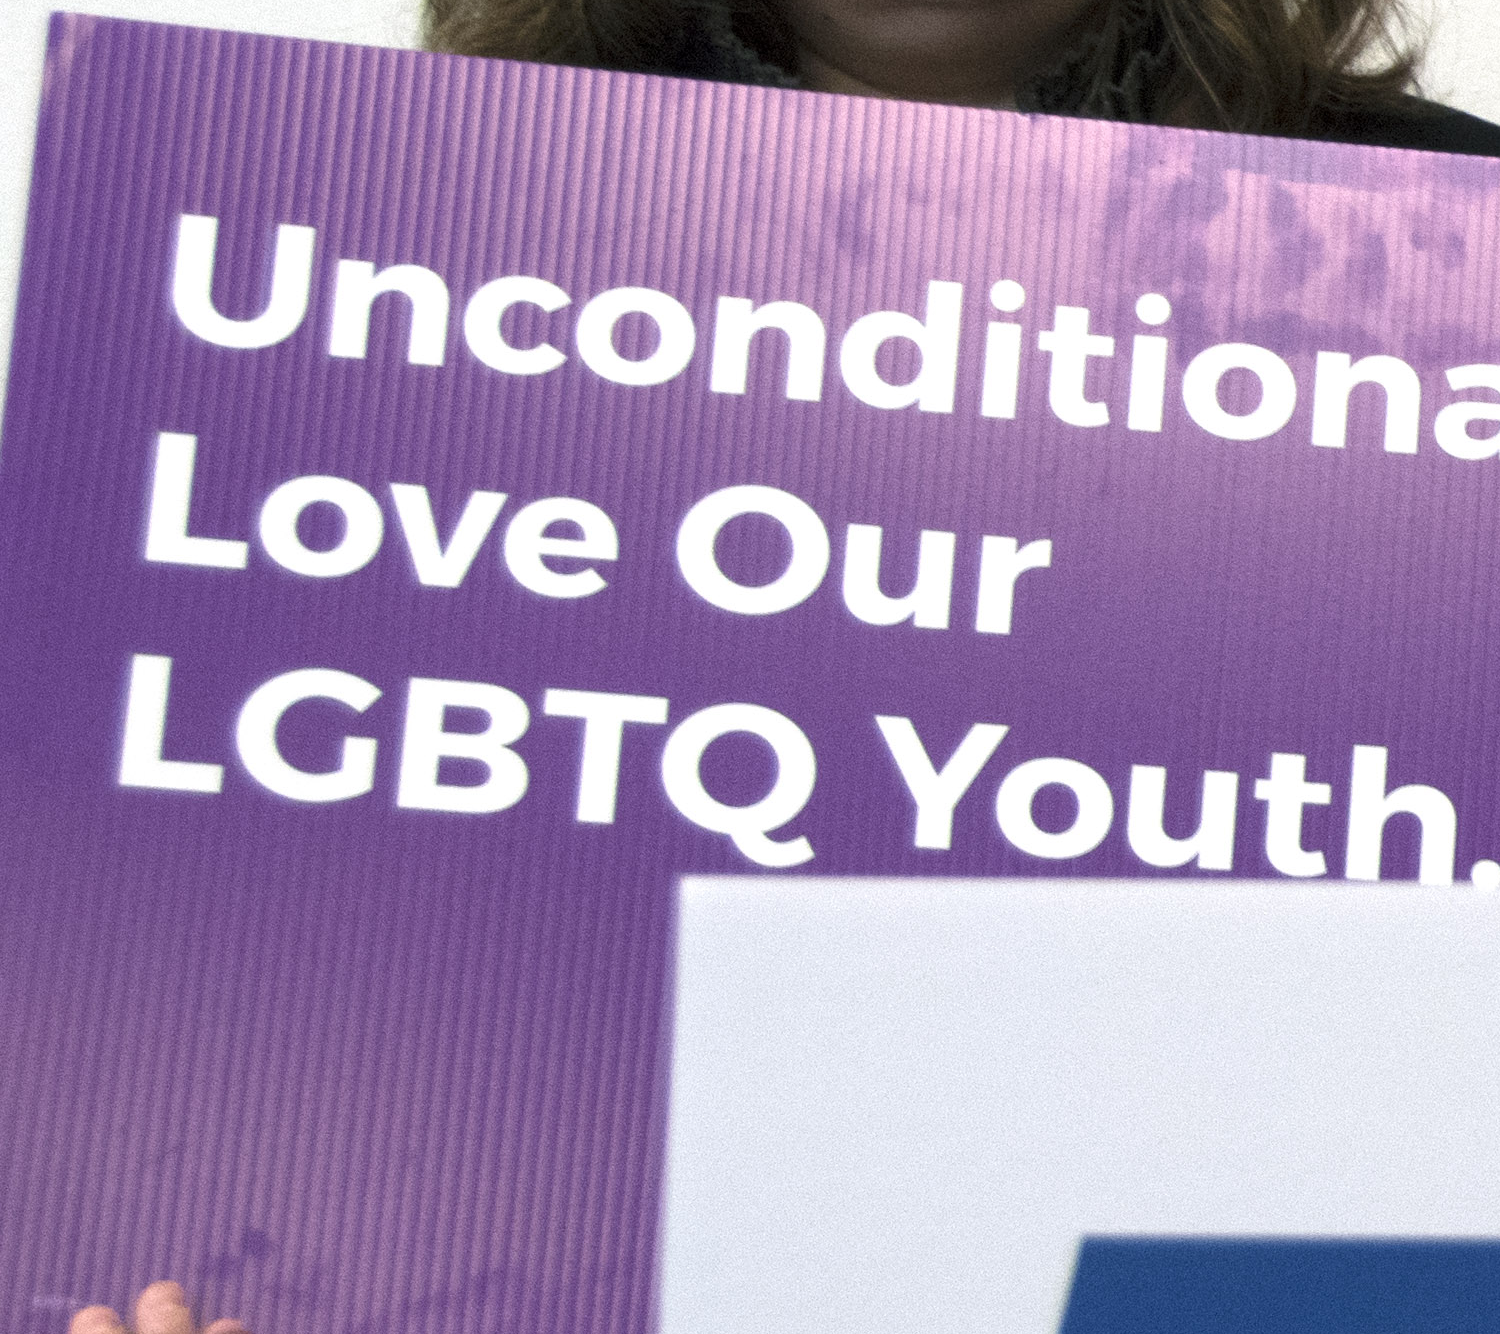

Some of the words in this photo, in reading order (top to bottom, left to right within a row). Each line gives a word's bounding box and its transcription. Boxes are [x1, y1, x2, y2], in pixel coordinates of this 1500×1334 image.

[144, 432, 618, 599] Love
[675, 484, 1052, 635] Our
[118, 653, 817, 867] LGBTQ
